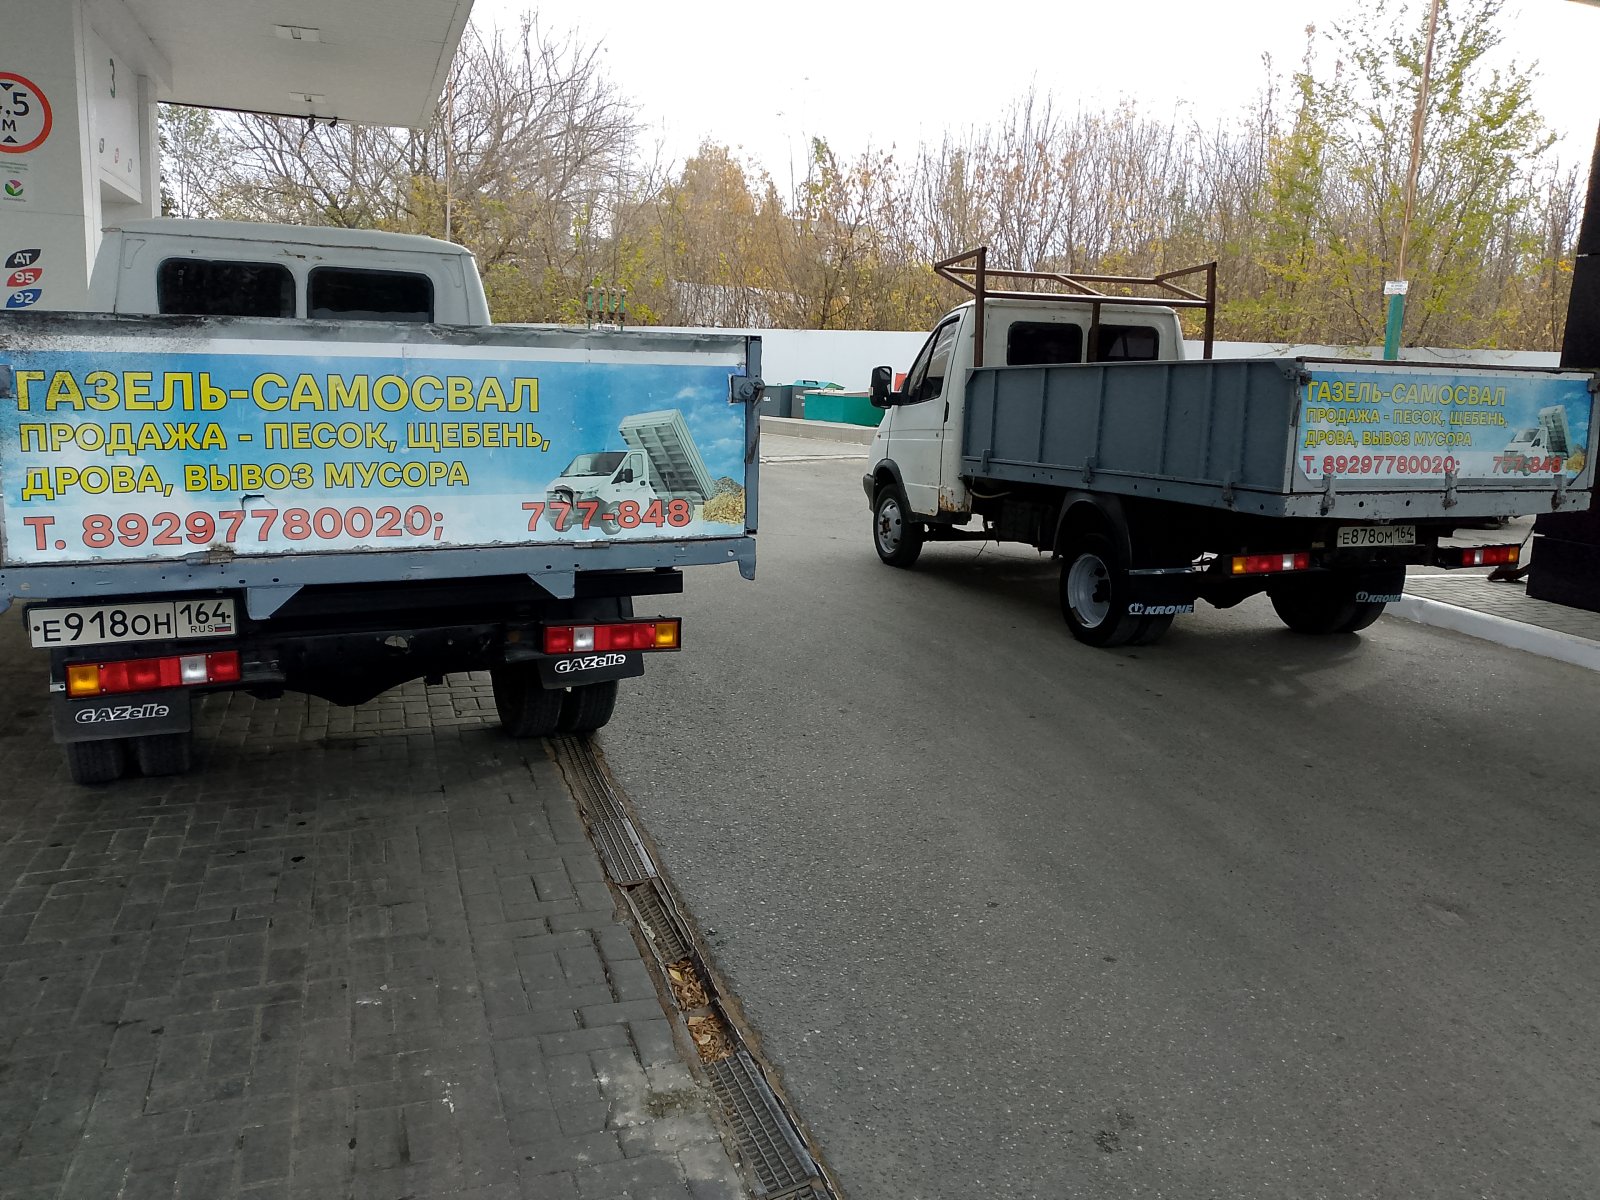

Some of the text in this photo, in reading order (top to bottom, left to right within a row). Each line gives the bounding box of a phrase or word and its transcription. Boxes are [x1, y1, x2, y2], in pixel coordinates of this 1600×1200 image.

[0, 92, 30, 117] ,5
[2, 119, 17, 132] М
[14, 272, 35, 284] 95
[13, 292, 34, 304] 92
[15, 370, 539, 412] ГАЗЕЛЬ-САМОСВАЛ
[1306, 380, 1507, 407] ГАЗЕЛЬ-САМОСВАЛ
[1305, 407, 1381, 427] ПРОДАЖА
[1393, 409, 1446, 426] ПЕСОК,
[1449, 410, 1509, 429] ЩЕБЕНЬ,
[18, 421, 551, 457] ПРОДАЖА - ПЕСОК, ЩЕБЕНЬ,
[1304, 429, 1473, 449] ДРОВА, ВЫВОЗ МУСОРА
[1303, 454, 1563, 475] Т. 89297780020; 777-848
[21, 460, 470, 502] ДРОВА, ВЫВОЗ МУСОРА
[23, 498, 692, 551] Т. 89297780020; 777-848
[1342, 526, 1414, 545] Е878ОМ 164
[1367, 593, 1402, 603] KRONE
[1144, 603, 1195, 616] KRONE
[42, 602, 227, 643] Е918ОН 164
[190, 624, 214, 634] RUS
[554, 655, 626, 673] GAZelle
[75, 704, 169, 723] GAZelle
